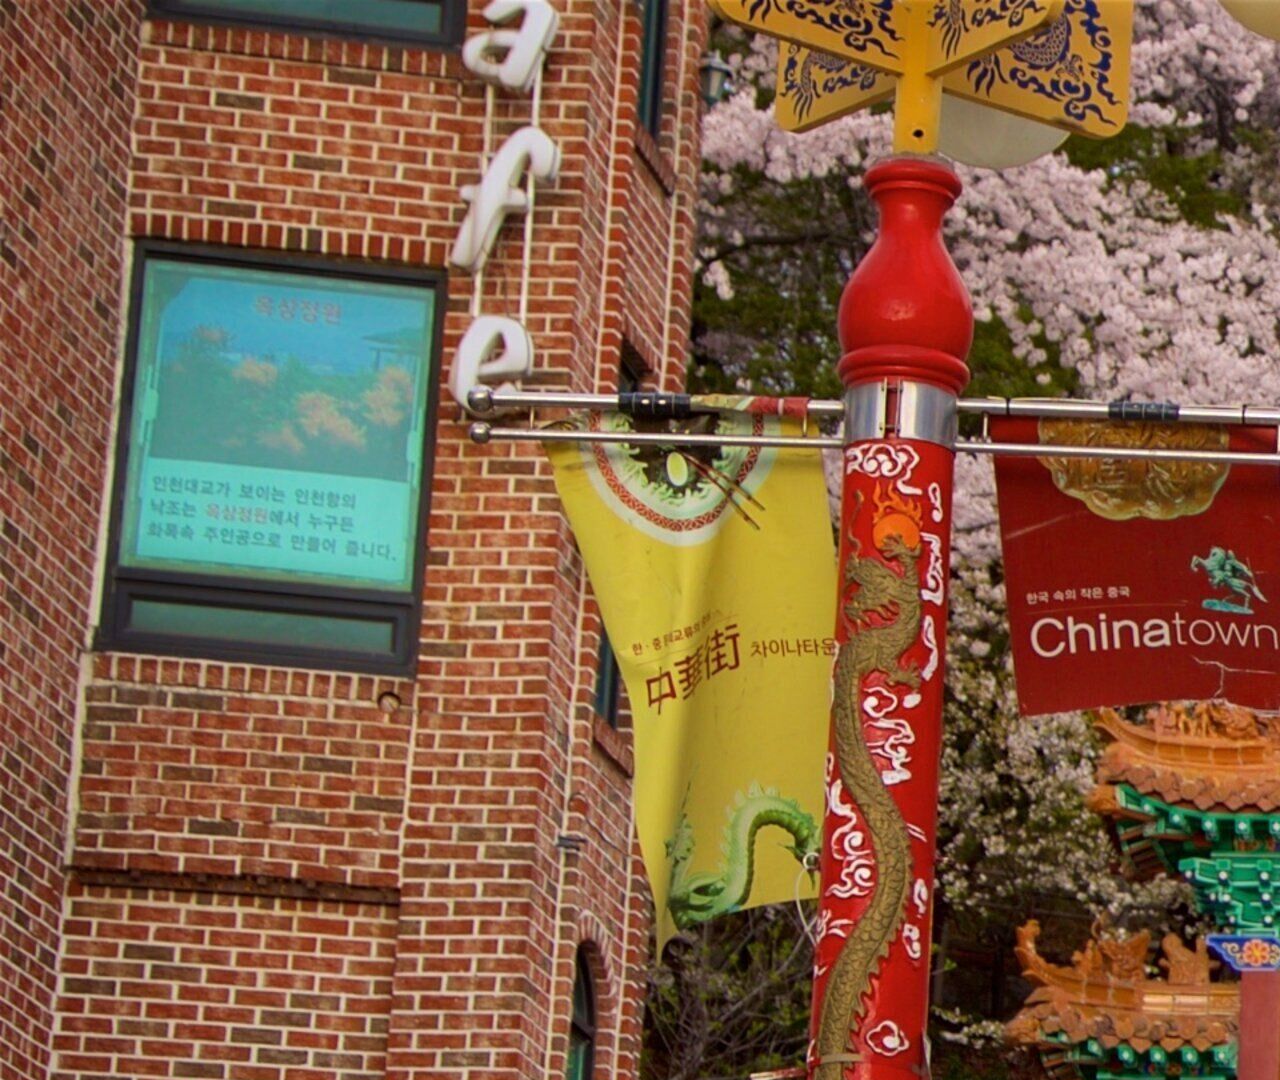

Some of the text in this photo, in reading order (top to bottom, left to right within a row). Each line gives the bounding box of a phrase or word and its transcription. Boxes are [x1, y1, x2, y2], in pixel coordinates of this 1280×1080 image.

[152, 475, 231, 498] 인천대교가
[239, 483, 286, 503] 보이는
[151, 499, 197, 518] 낙조는
[204, 526, 282, 548] 주인공으로
[290, 534, 336, 555] 만들어
[1027, 586, 1130, 605] 한국 속의 작은 중국
[1030, 611, 1279, 657] Chinatown
[750, 637, 837, 658] 차이나타운
